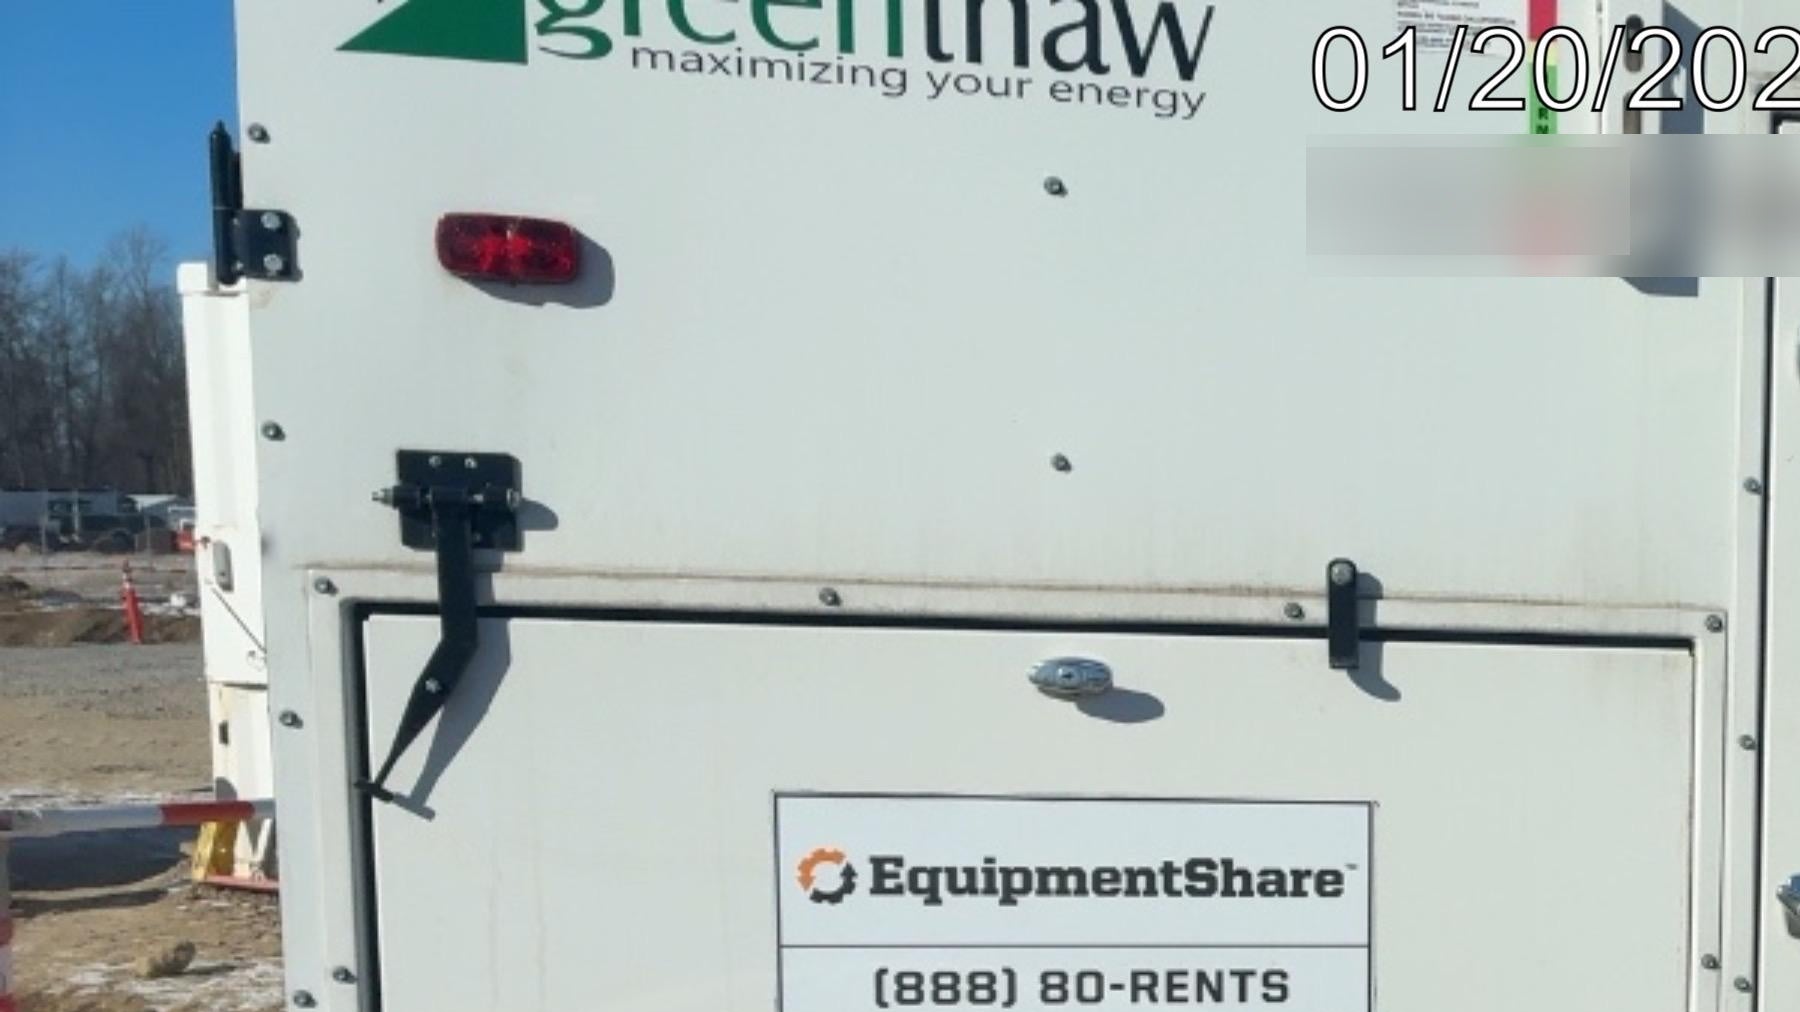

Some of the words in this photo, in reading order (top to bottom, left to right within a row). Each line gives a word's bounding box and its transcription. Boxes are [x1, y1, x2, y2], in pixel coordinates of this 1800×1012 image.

[631, 46, 908, 97] maximizing
[927, 70, 1031, 100] your
[1050, 78, 1206, 120] energy
[874, 968, 1017, 1008] (888)
[1039, 969, 1290, 1004] 80-RENTS
